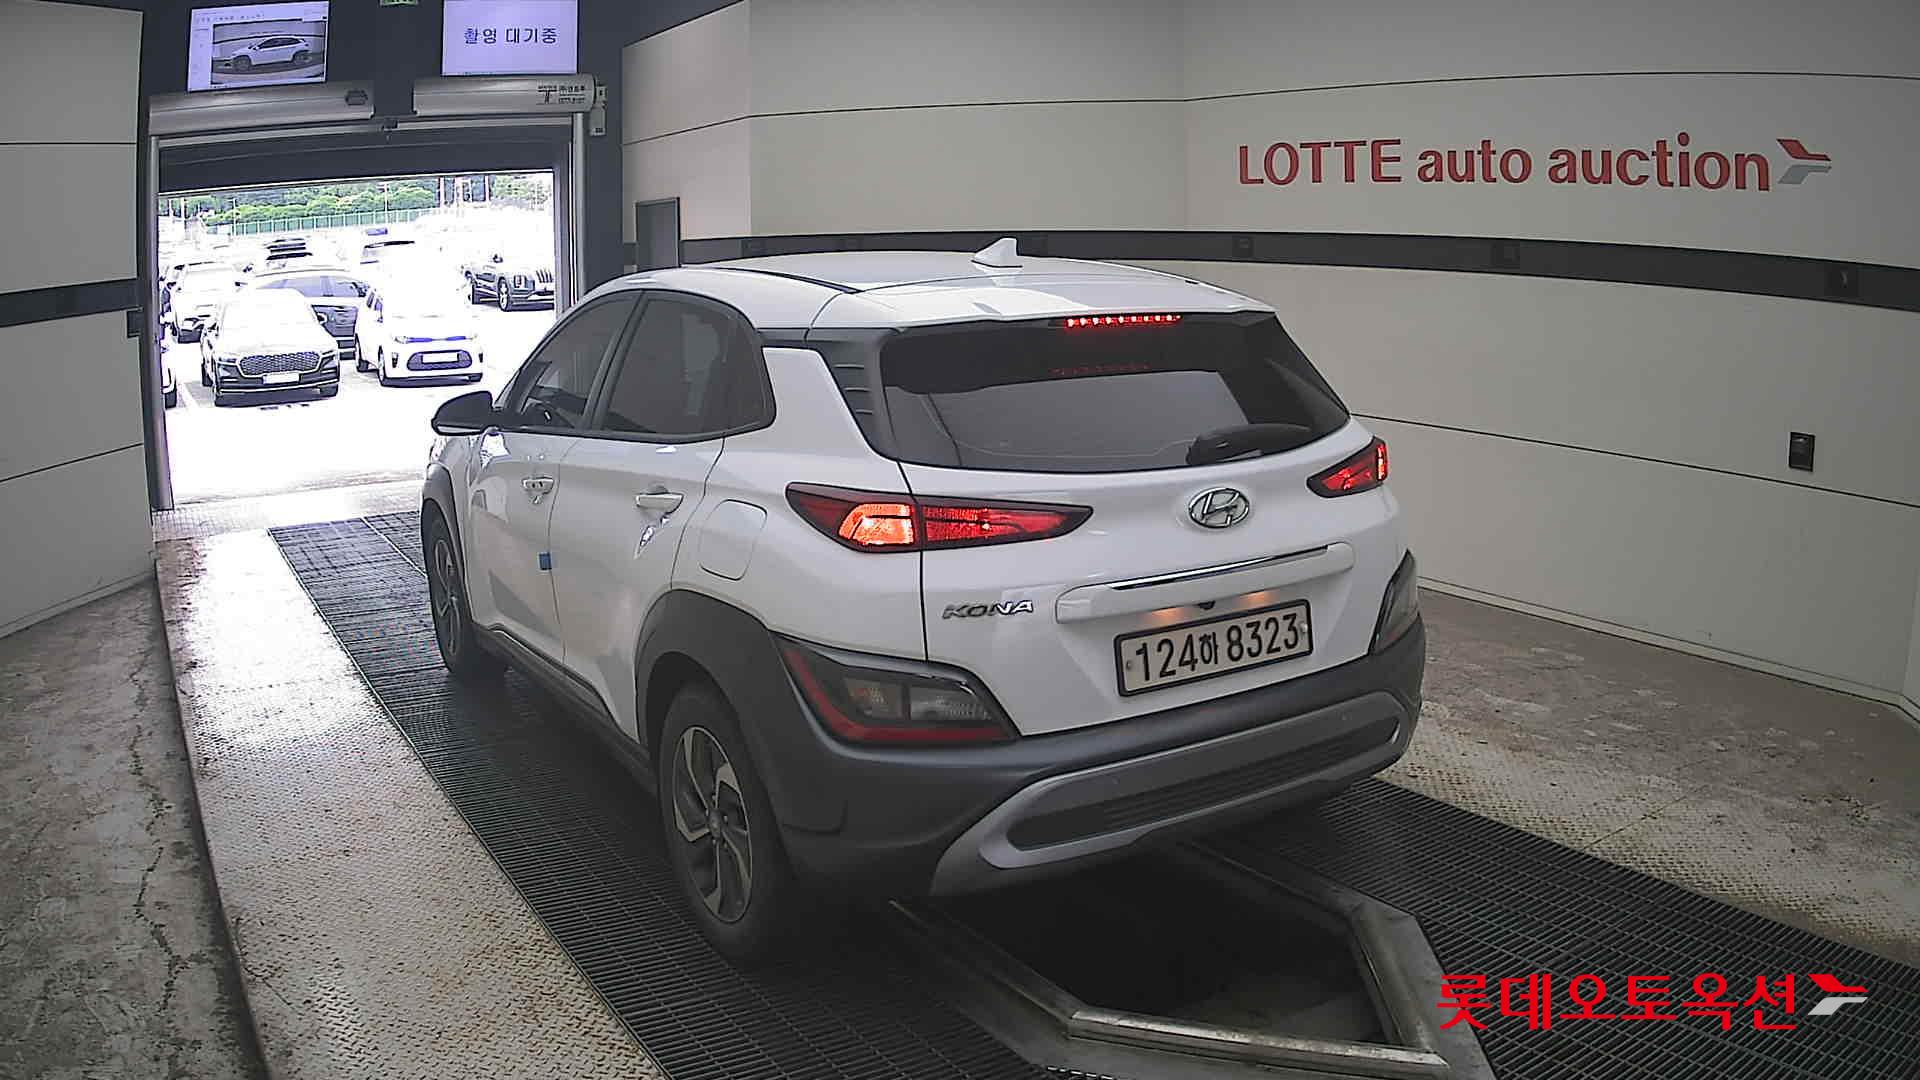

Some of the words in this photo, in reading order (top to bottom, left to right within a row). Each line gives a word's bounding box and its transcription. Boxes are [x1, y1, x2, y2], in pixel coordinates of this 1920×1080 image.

[464, 27, 497, 45] 촬영
[505, 27, 558, 45] 대기중
[1238, 138, 1402, 187] LOTTE
[1417, 140, 1533, 185] auto
[1548, 131, 1771, 192] auction
[941, 599, 1034, 620] KONA
[1135, 631, 1219, 682] 124하
[1226, 612, 1300, 663] 8323
